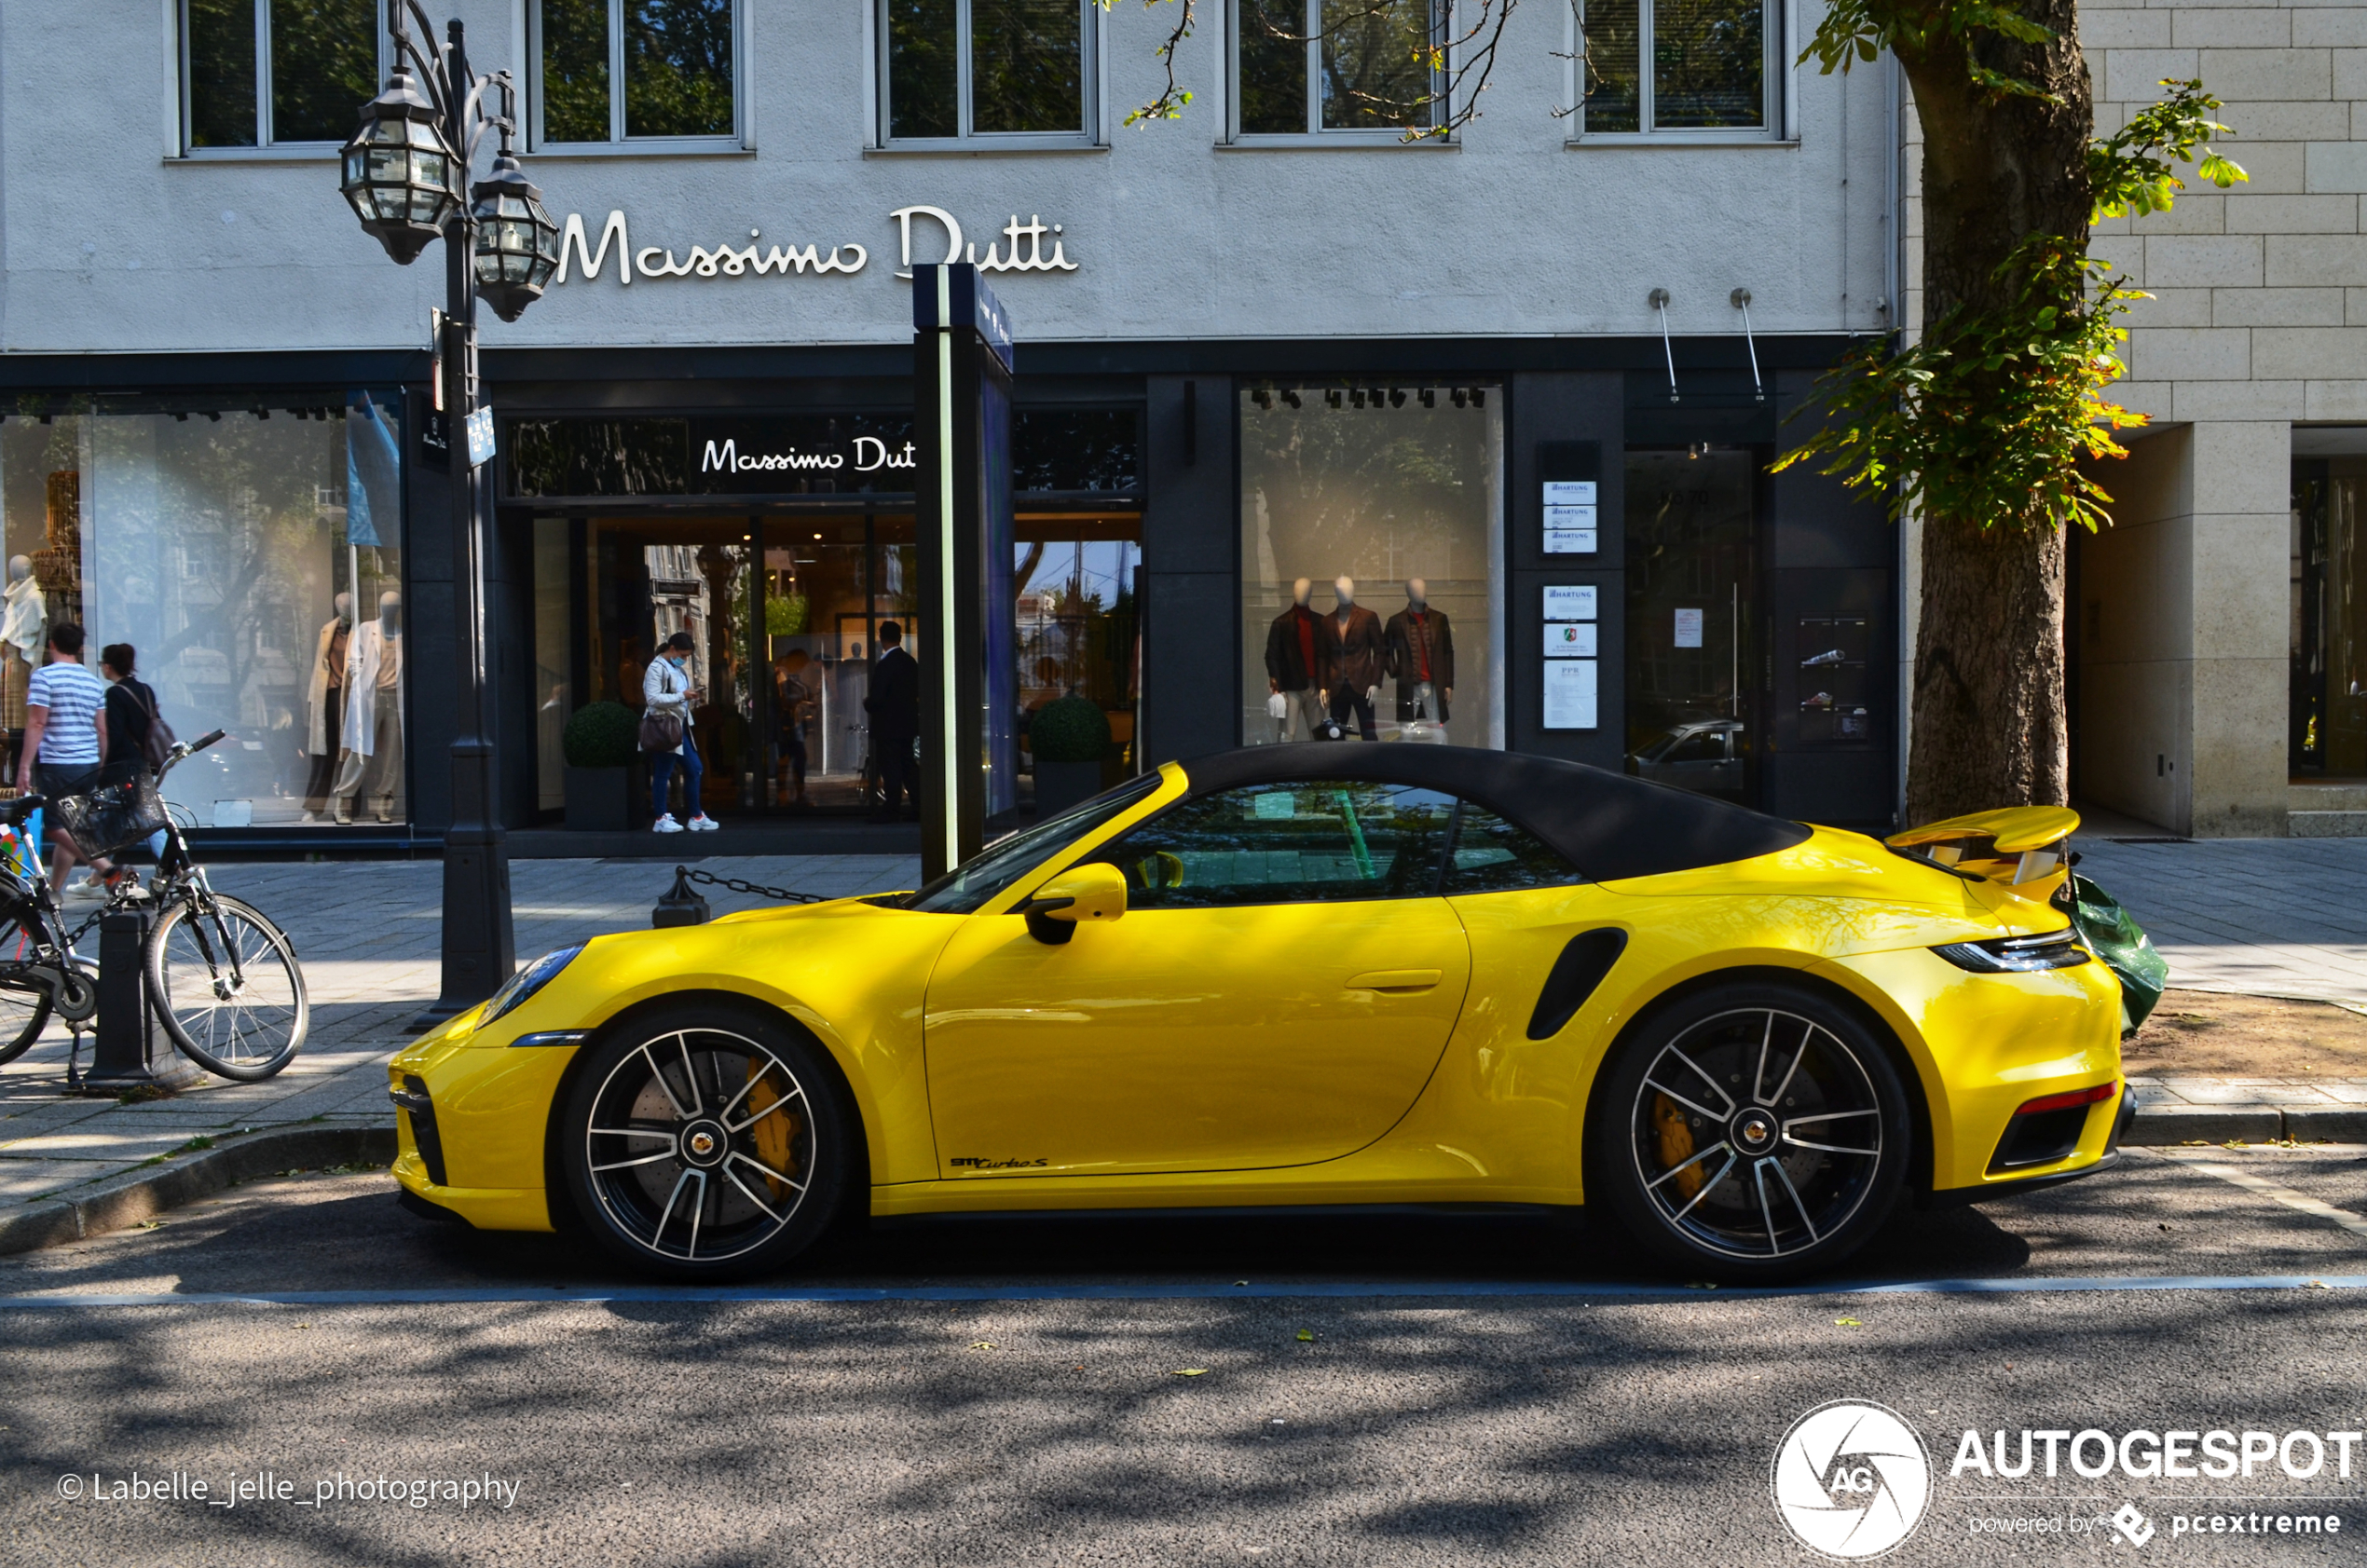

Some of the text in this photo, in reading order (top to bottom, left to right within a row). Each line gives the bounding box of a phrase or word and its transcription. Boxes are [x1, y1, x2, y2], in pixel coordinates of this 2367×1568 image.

[557, 205, 1079, 284] Massimo Dutti
[702, 436, 917, 473] Massimo Dut
